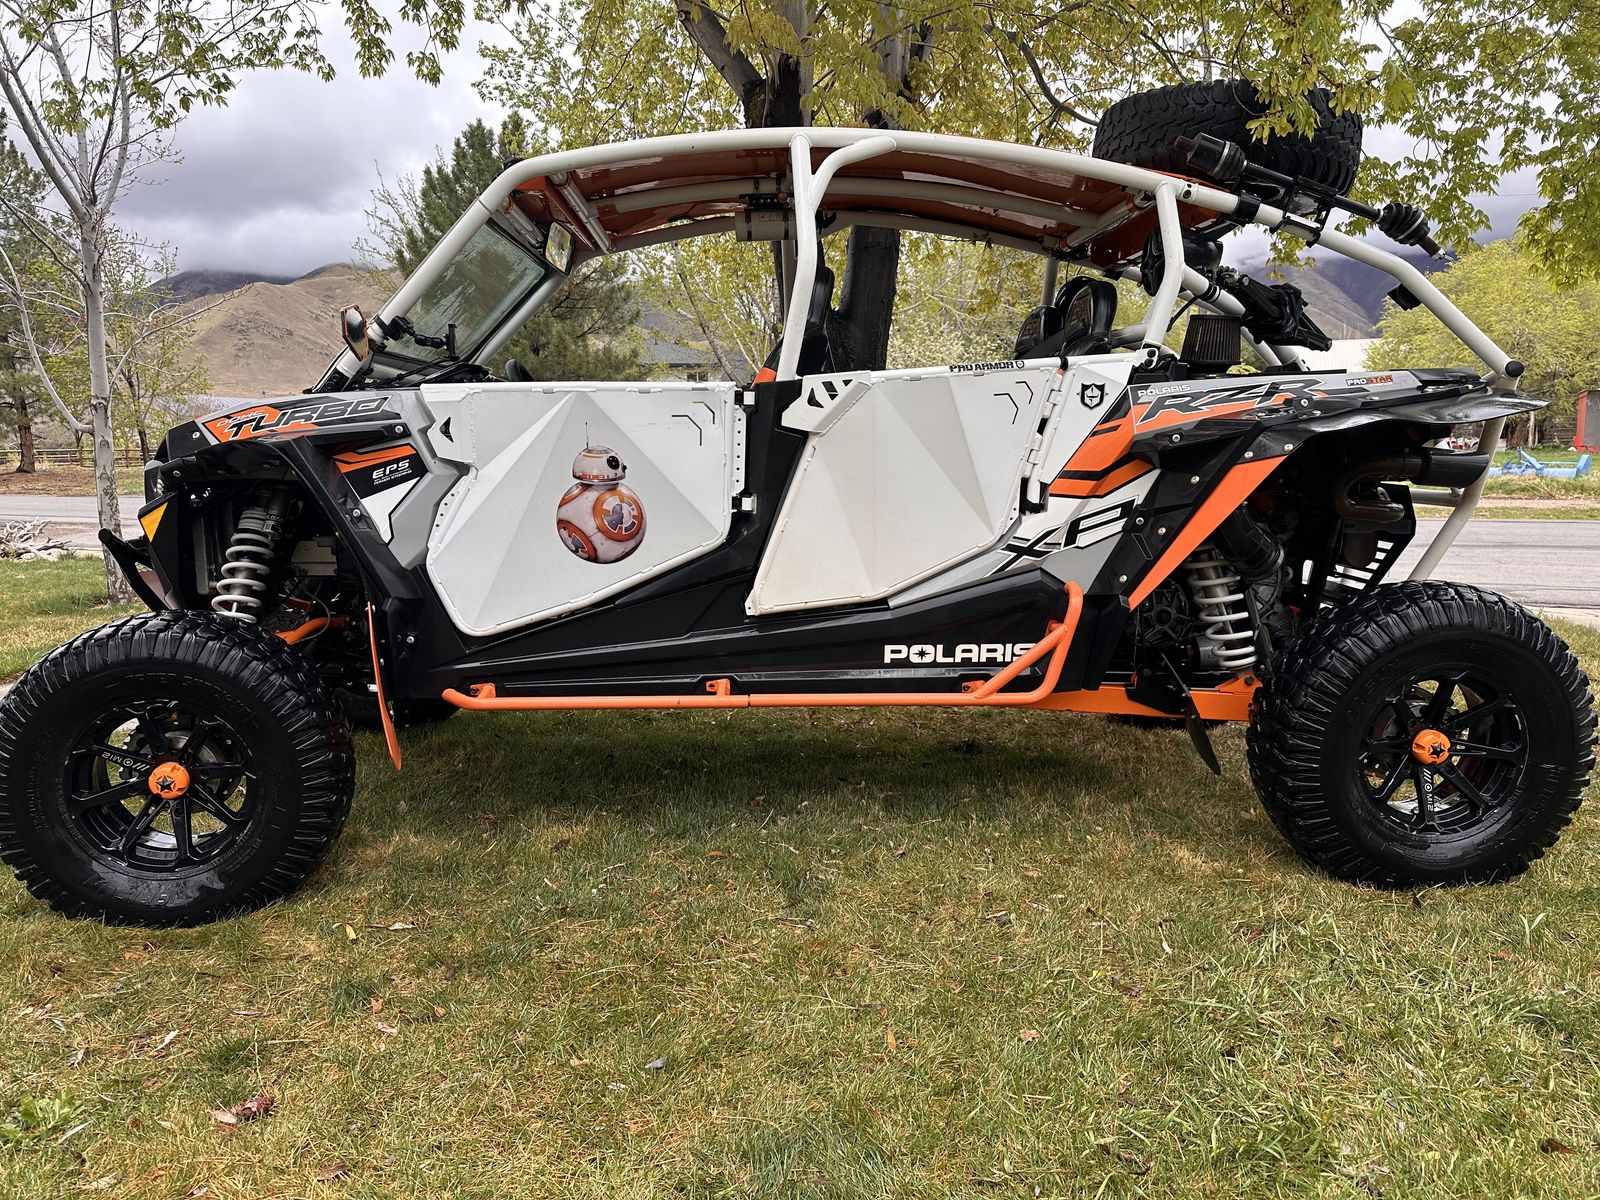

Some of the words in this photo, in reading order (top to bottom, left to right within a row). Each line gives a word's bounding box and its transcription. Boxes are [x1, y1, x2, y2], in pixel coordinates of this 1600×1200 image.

[949, 364, 974, 372] PRO
[974, 361, 1014, 371] ARMOR
[1347, 375, 1393, 385] PROSTAR
[1137, 384, 1191, 397] POLARIS
[1136, 378, 1327, 426] RZR
[223, 395, 392, 440] TURBO
[372, 459, 410, 479] EPS
[983, 494, 1139, 578] XP
[883, 643, 1037, 663] POLARIS
